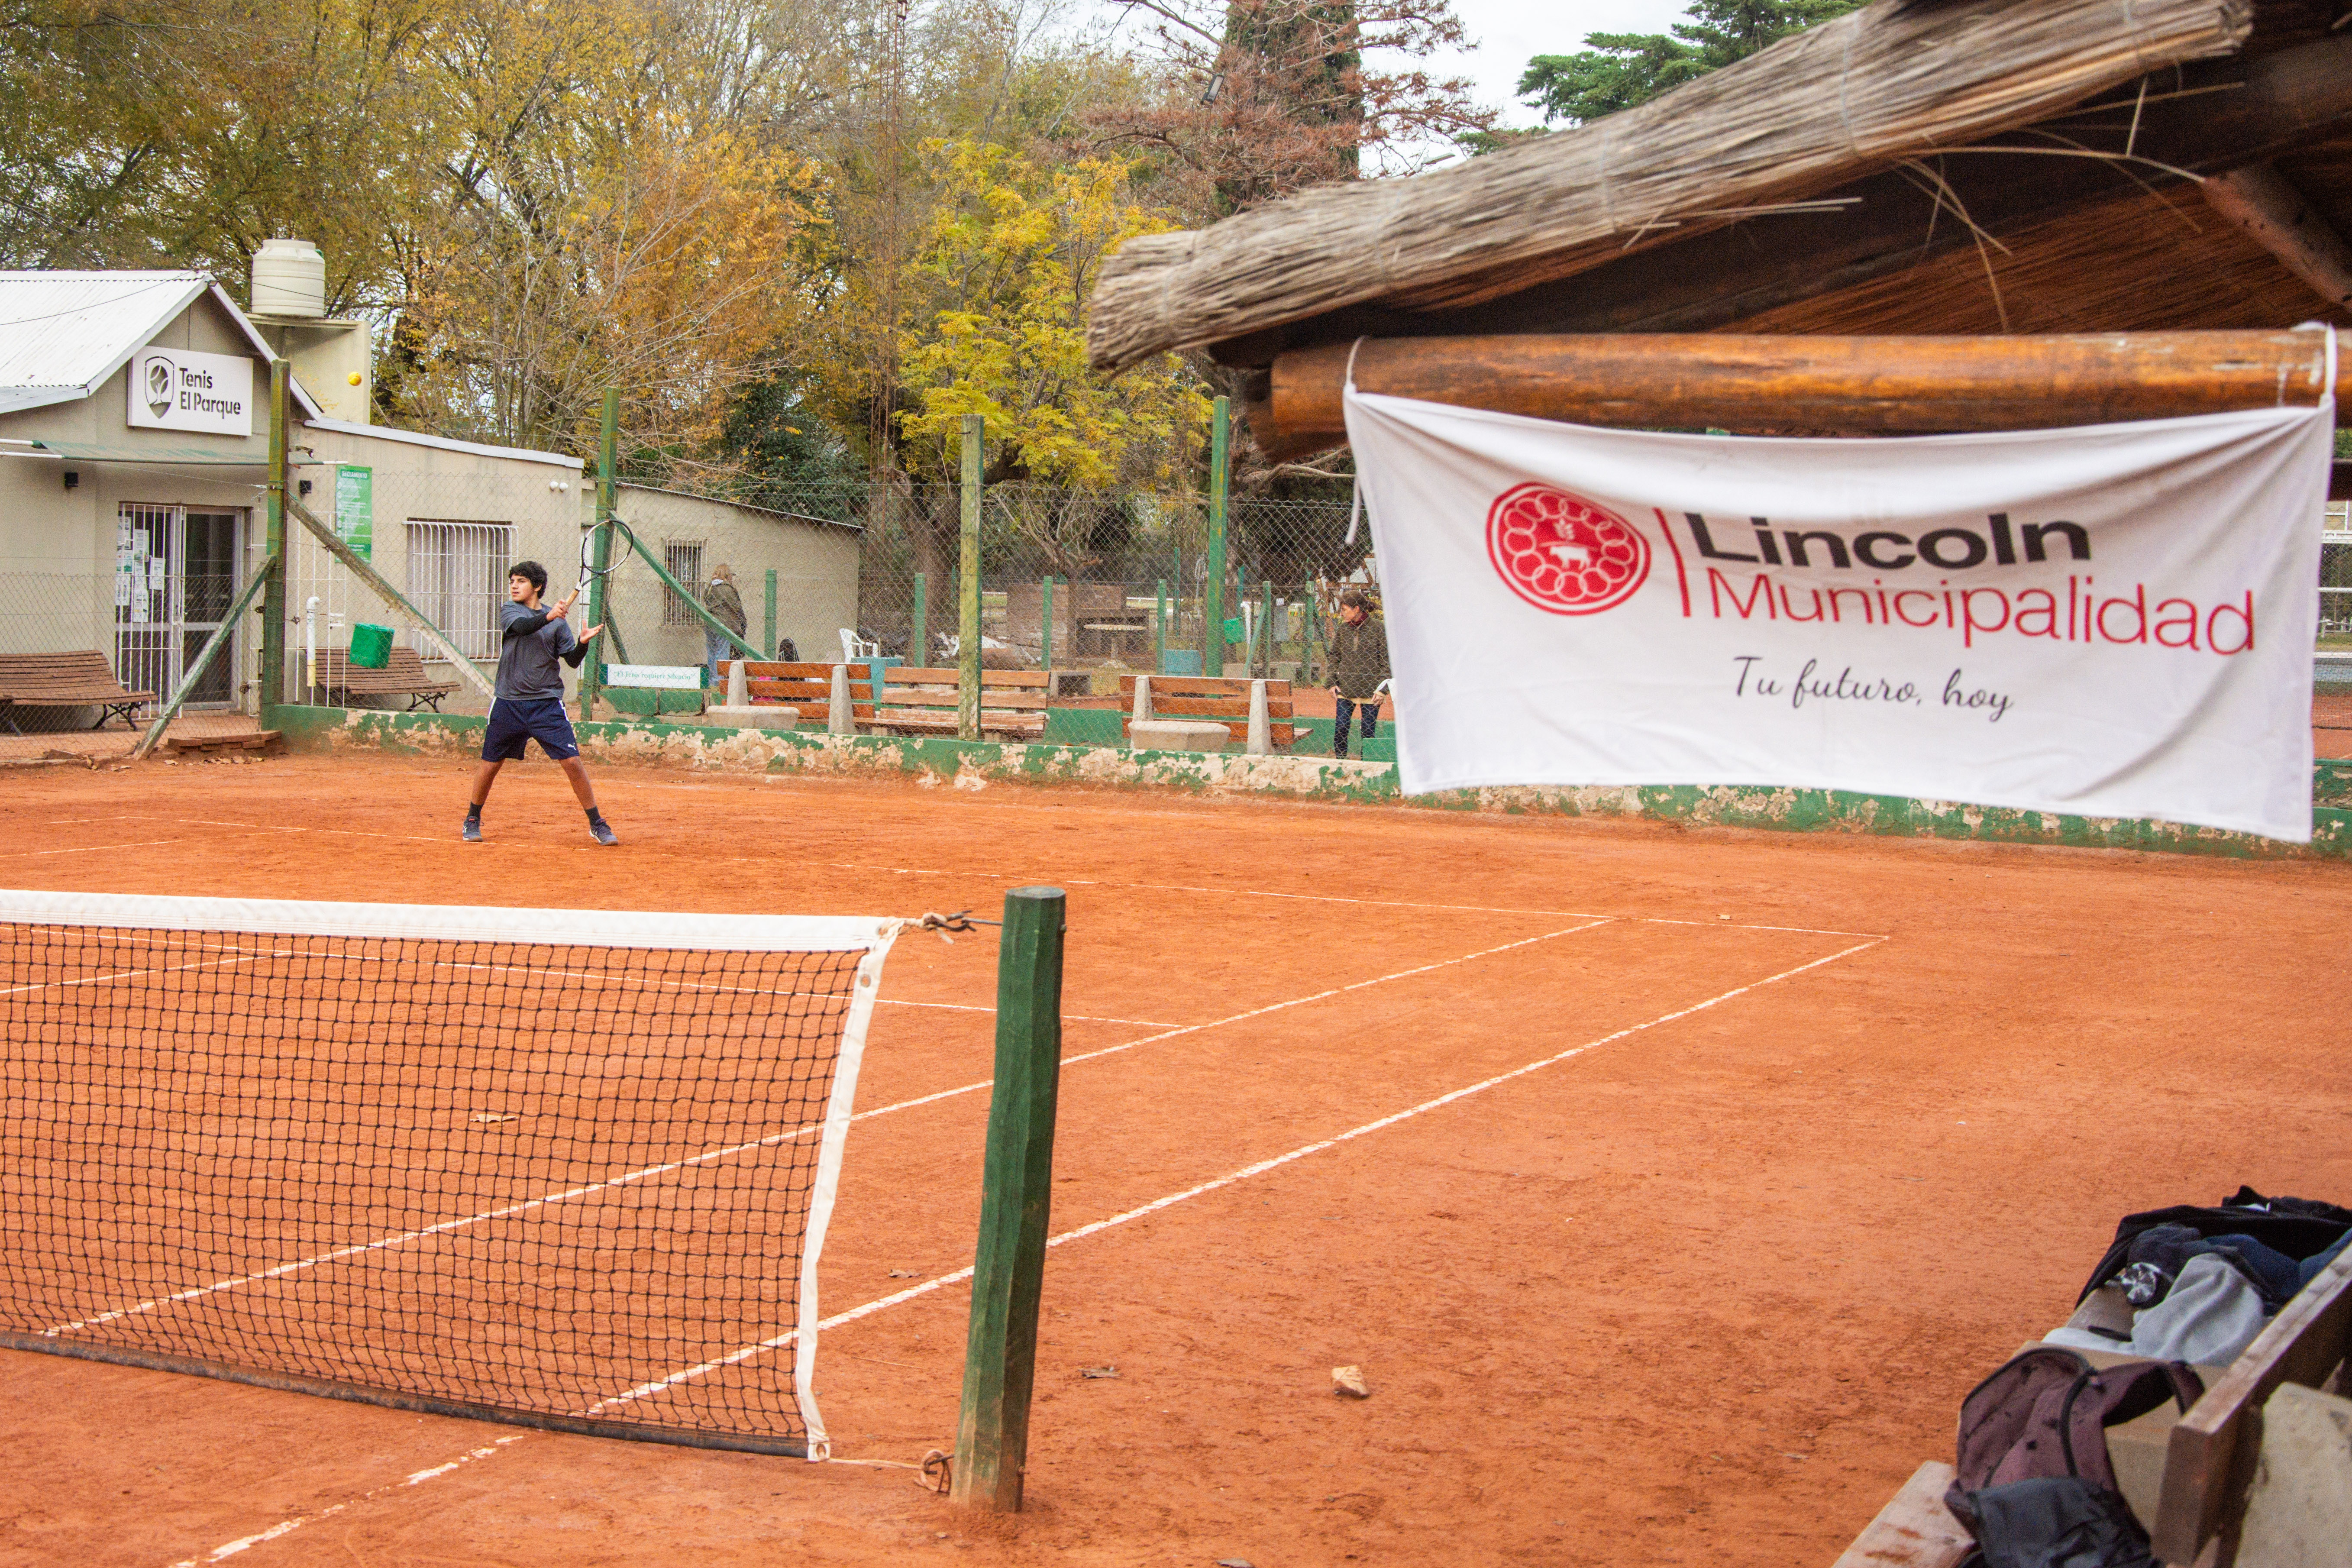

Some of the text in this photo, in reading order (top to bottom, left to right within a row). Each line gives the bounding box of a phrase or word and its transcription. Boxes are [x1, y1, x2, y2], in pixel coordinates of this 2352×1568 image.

[179, 367, 213, 389] Tenis
[180, 391, 241, 419] El Parque
[1683, 512, 2092, 570] Lincoln
[1707, 567, 2254, 655] Municipalidad
[1733, 656, 2013, 722] Tu futuro, hoy
